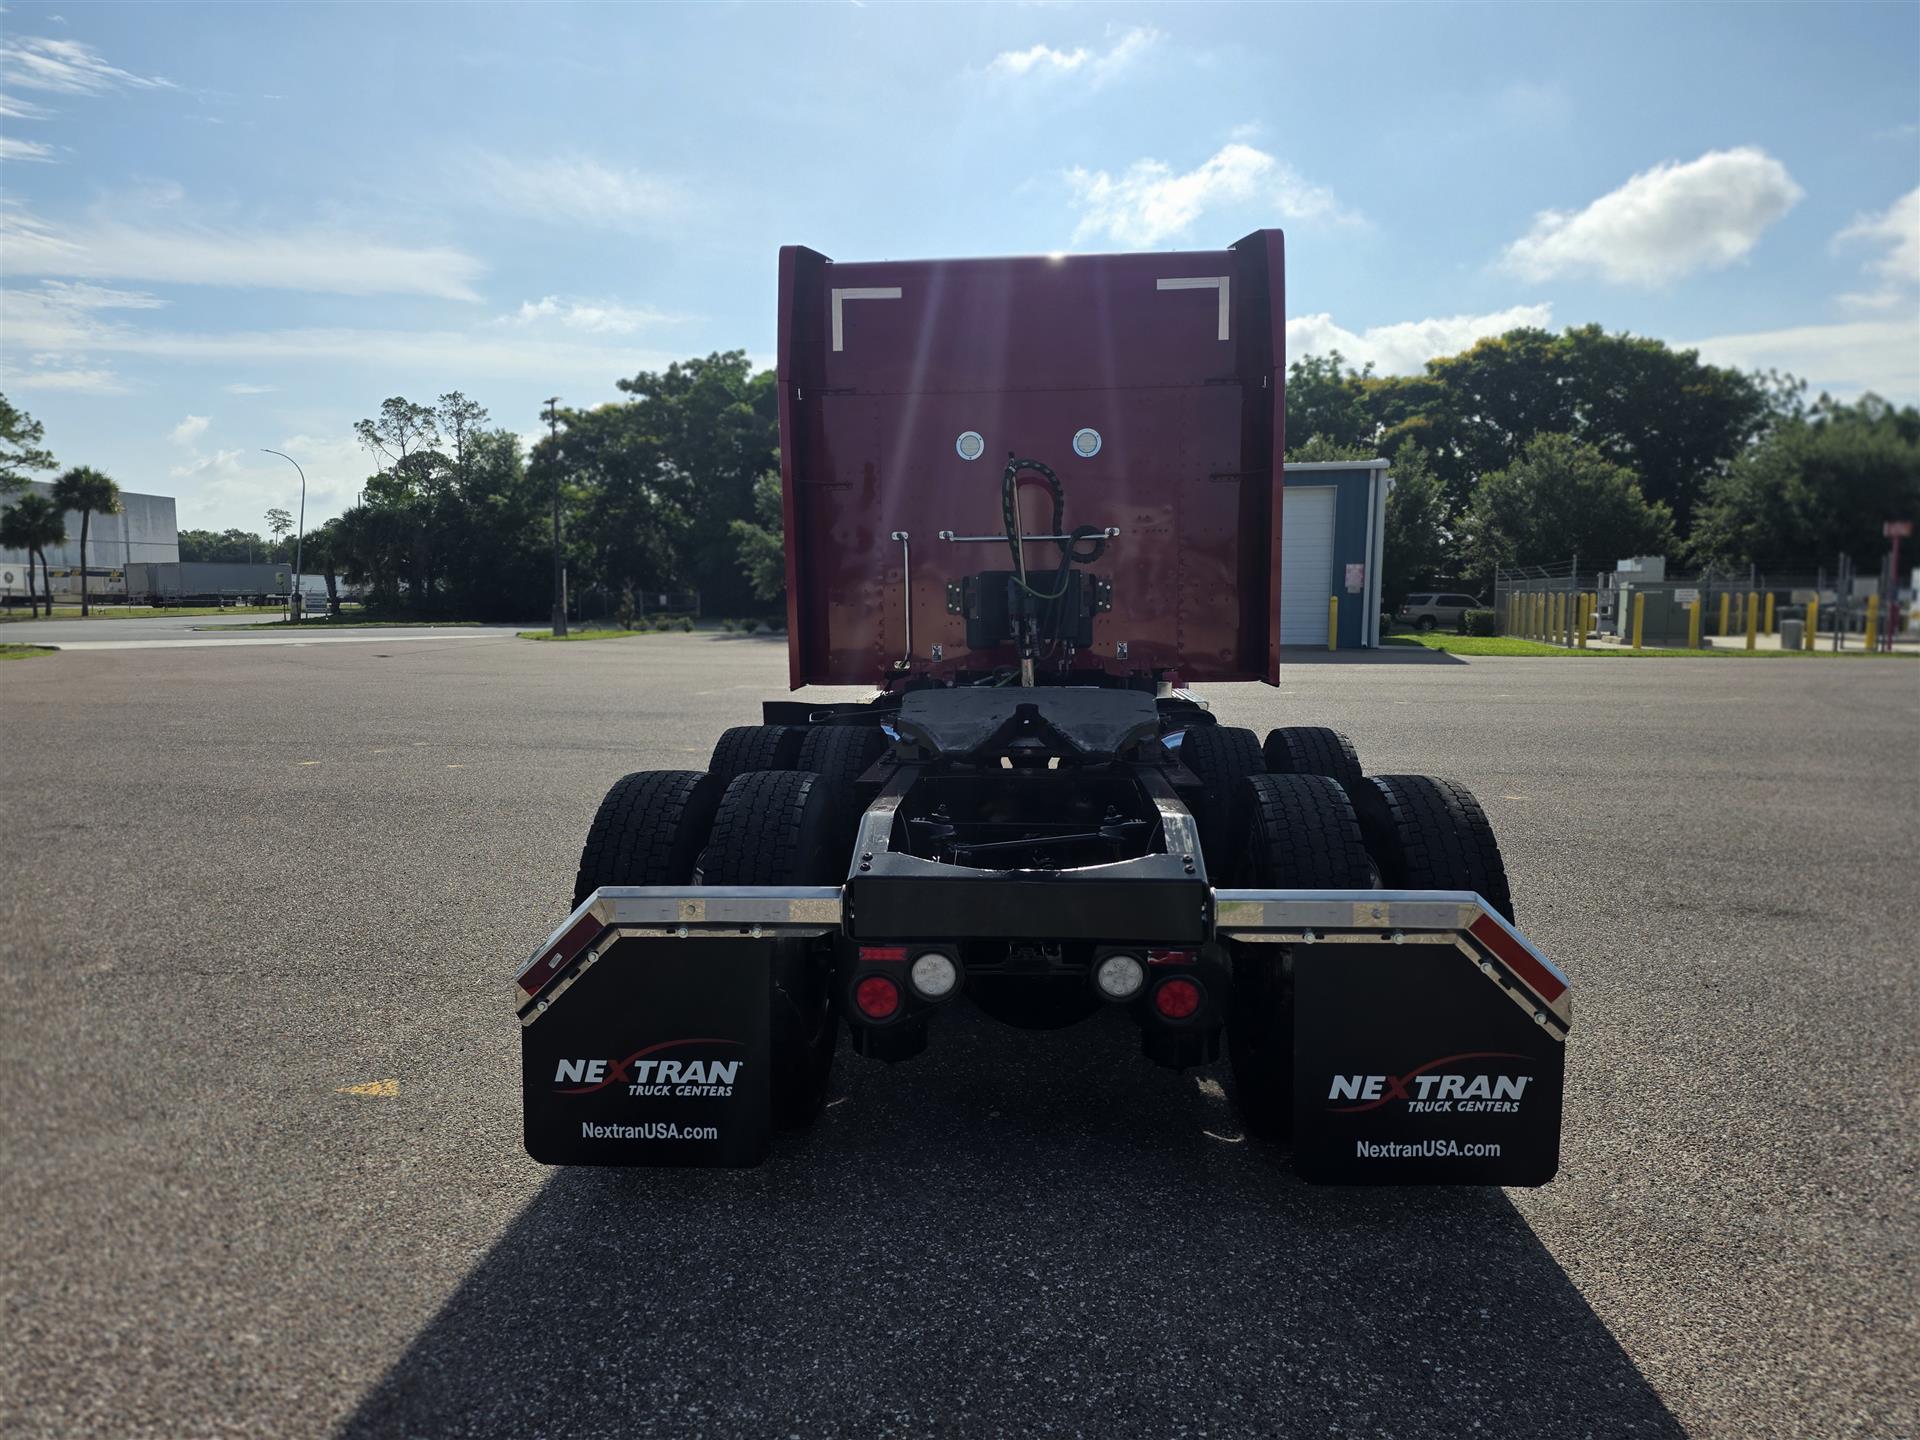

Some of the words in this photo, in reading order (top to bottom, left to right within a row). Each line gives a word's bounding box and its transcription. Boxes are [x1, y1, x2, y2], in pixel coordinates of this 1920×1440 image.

[554, 1059, 739, 1084] NEXTRAN
[628, 1085, 670, 1096] TRUCK
[676, 1085, 733, 1097] CENTERS
[1328, 1075, 1528, 1100] NEXTRAN
[1408, 1101, 1451, 1112] TRUCK
[1457, 1101, 1520, 1113] CENTERS
[582, 1122, 718, 1140] NextranUSA.com
[1357, 1140, 1501, 1158] NextranUSA.com
